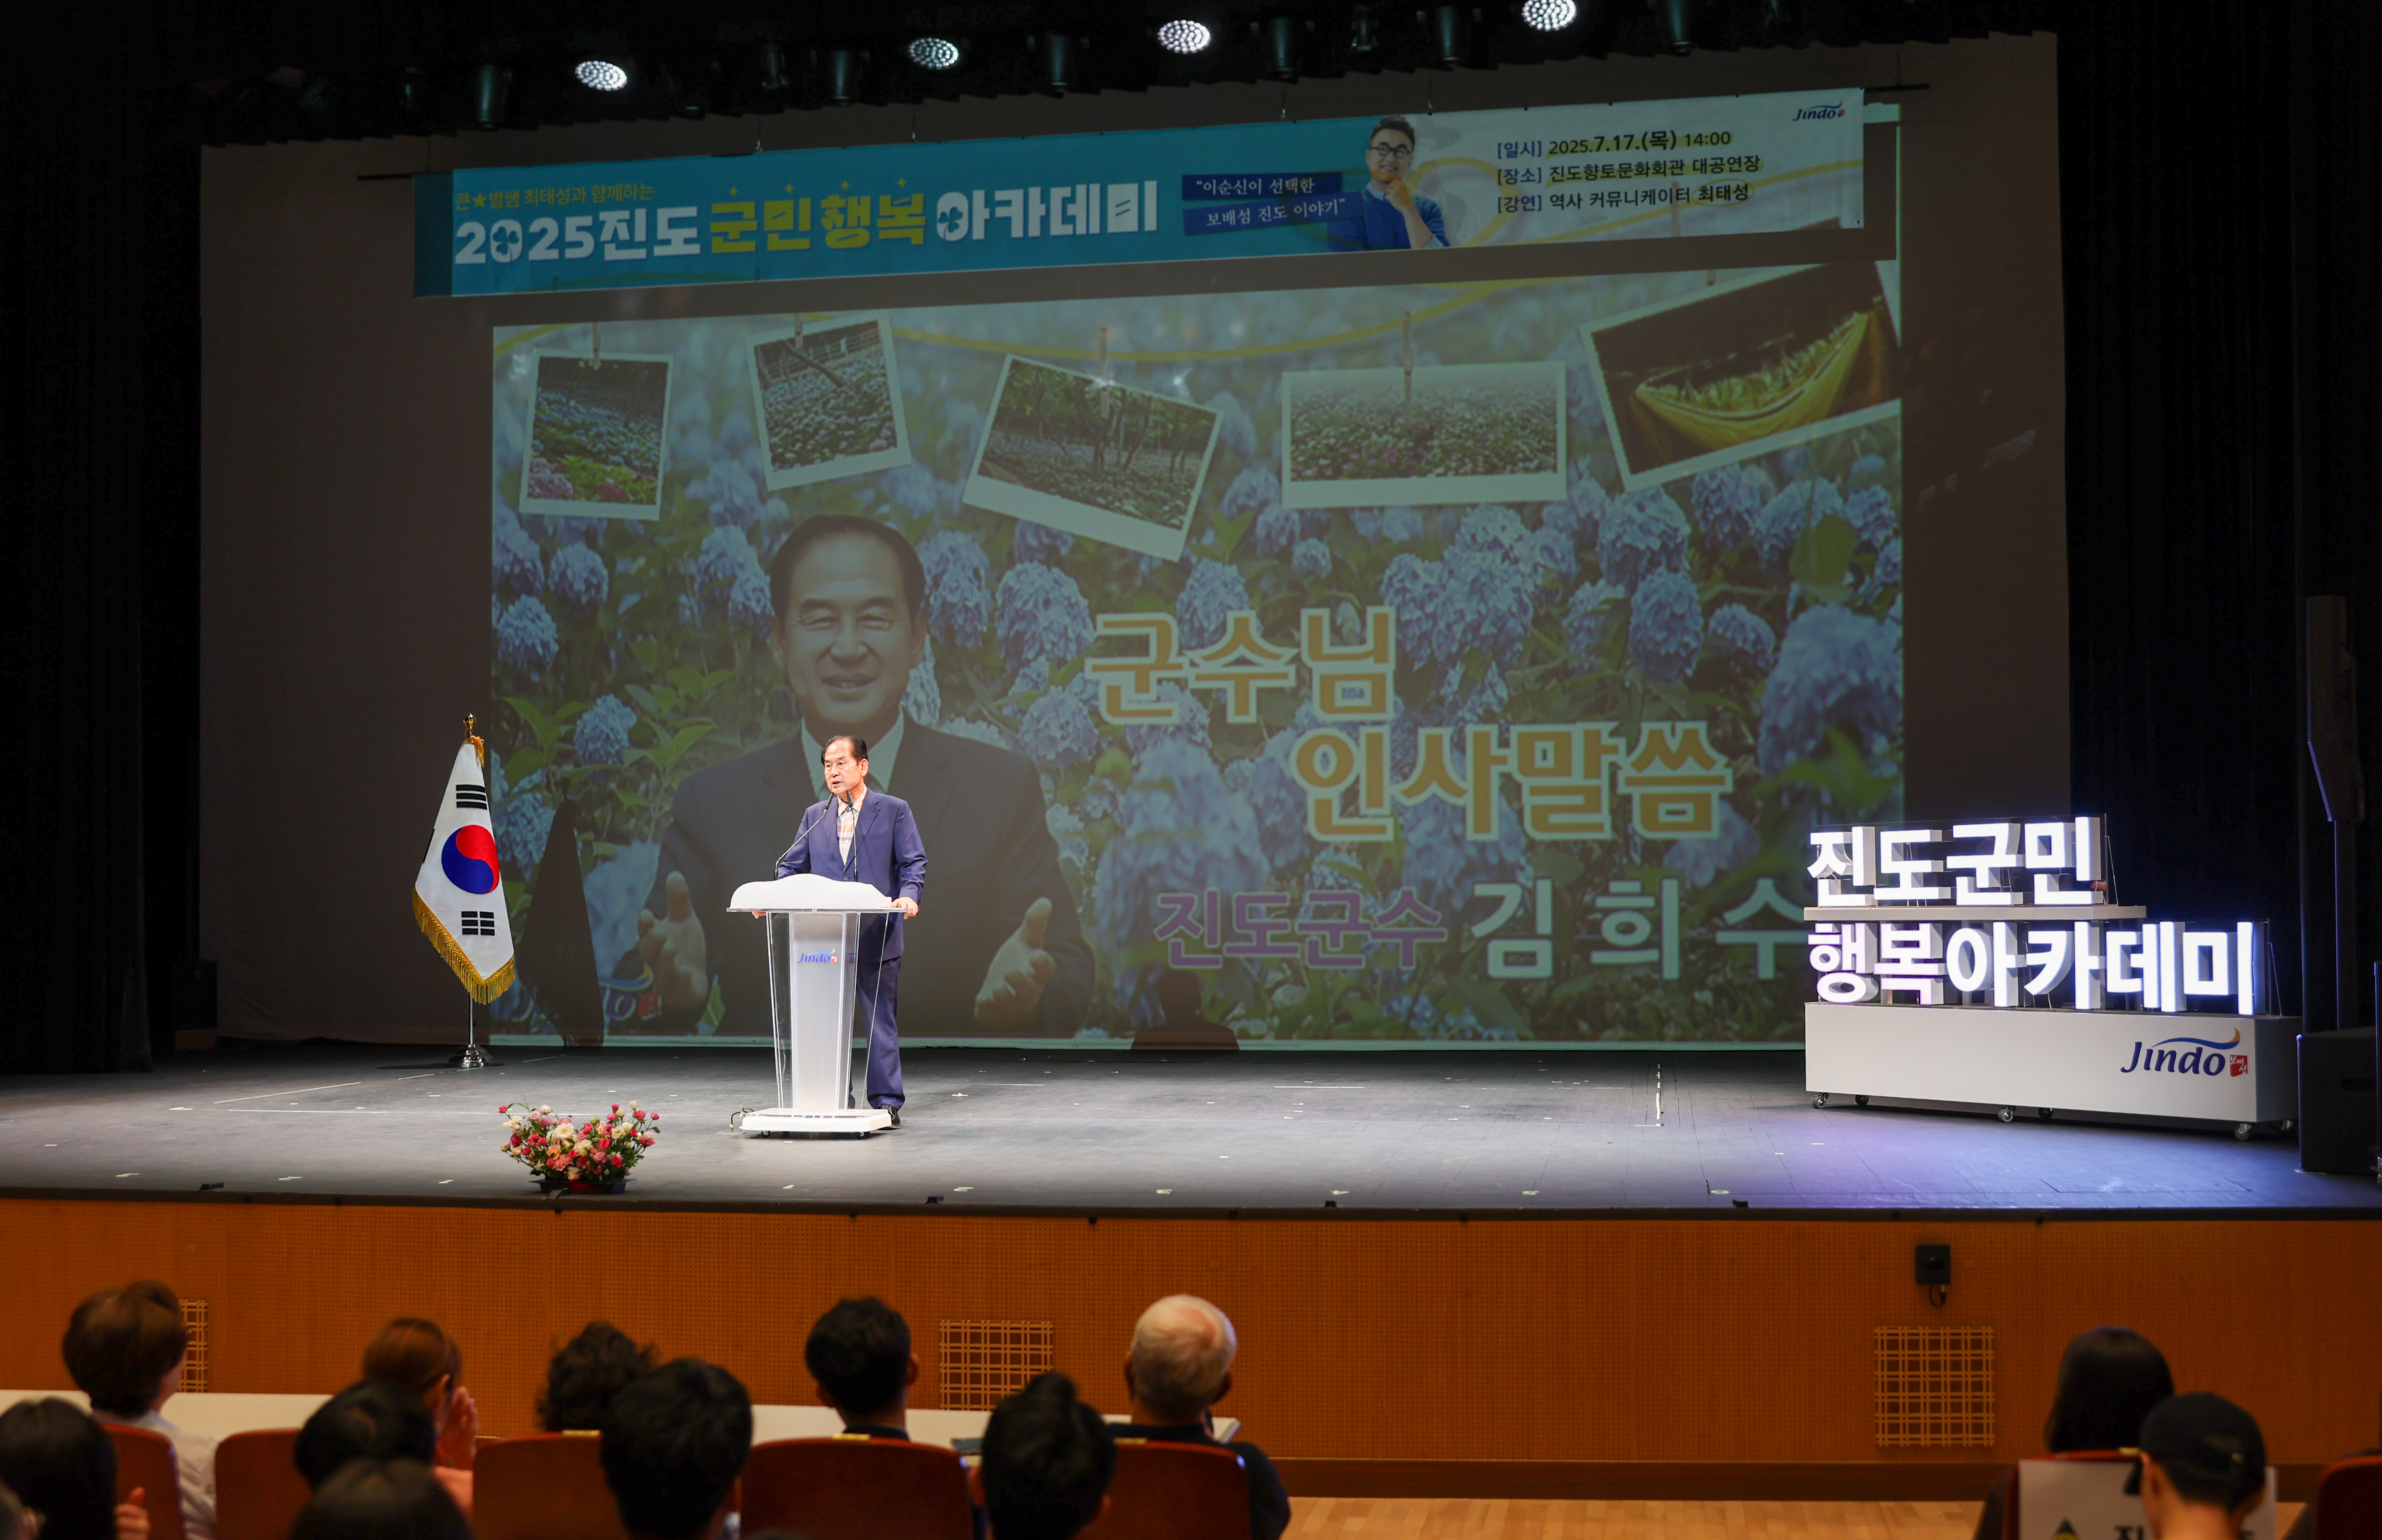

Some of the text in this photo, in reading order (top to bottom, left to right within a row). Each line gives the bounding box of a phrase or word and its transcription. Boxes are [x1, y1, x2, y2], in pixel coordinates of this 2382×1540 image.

[1792, 108, 1836, 122] Jindo
[1497, 130, 1731, 159] [일시] 2025.7.17.(목) 14:00
[1497, 155, 1760, 186] [장소] 진도향토문화회관 대공연장
[524, 186, 587, 206] 최태성과
[591, 183, 655, 204] 함께하는
[1269, 178, 1315, 194] 선택한
[1497, 184, 1748, 214] [강연] 역사 커뮤니케이터 최태성
[1206, 208, 1251, 226] 보배섬
[1258, 205, 1288, 222] 진도
[1084, 606, 1397, 725] 군수님
[1288, 721, 1733, 841] 인사말씀
[1807, 816, 2103, 907] 진도군민
[1154, 888, 1448, 971] 진도군수
[797, 953, 831, 963] Jindo
[2120, 1041, 2226, 1076] Jindo
